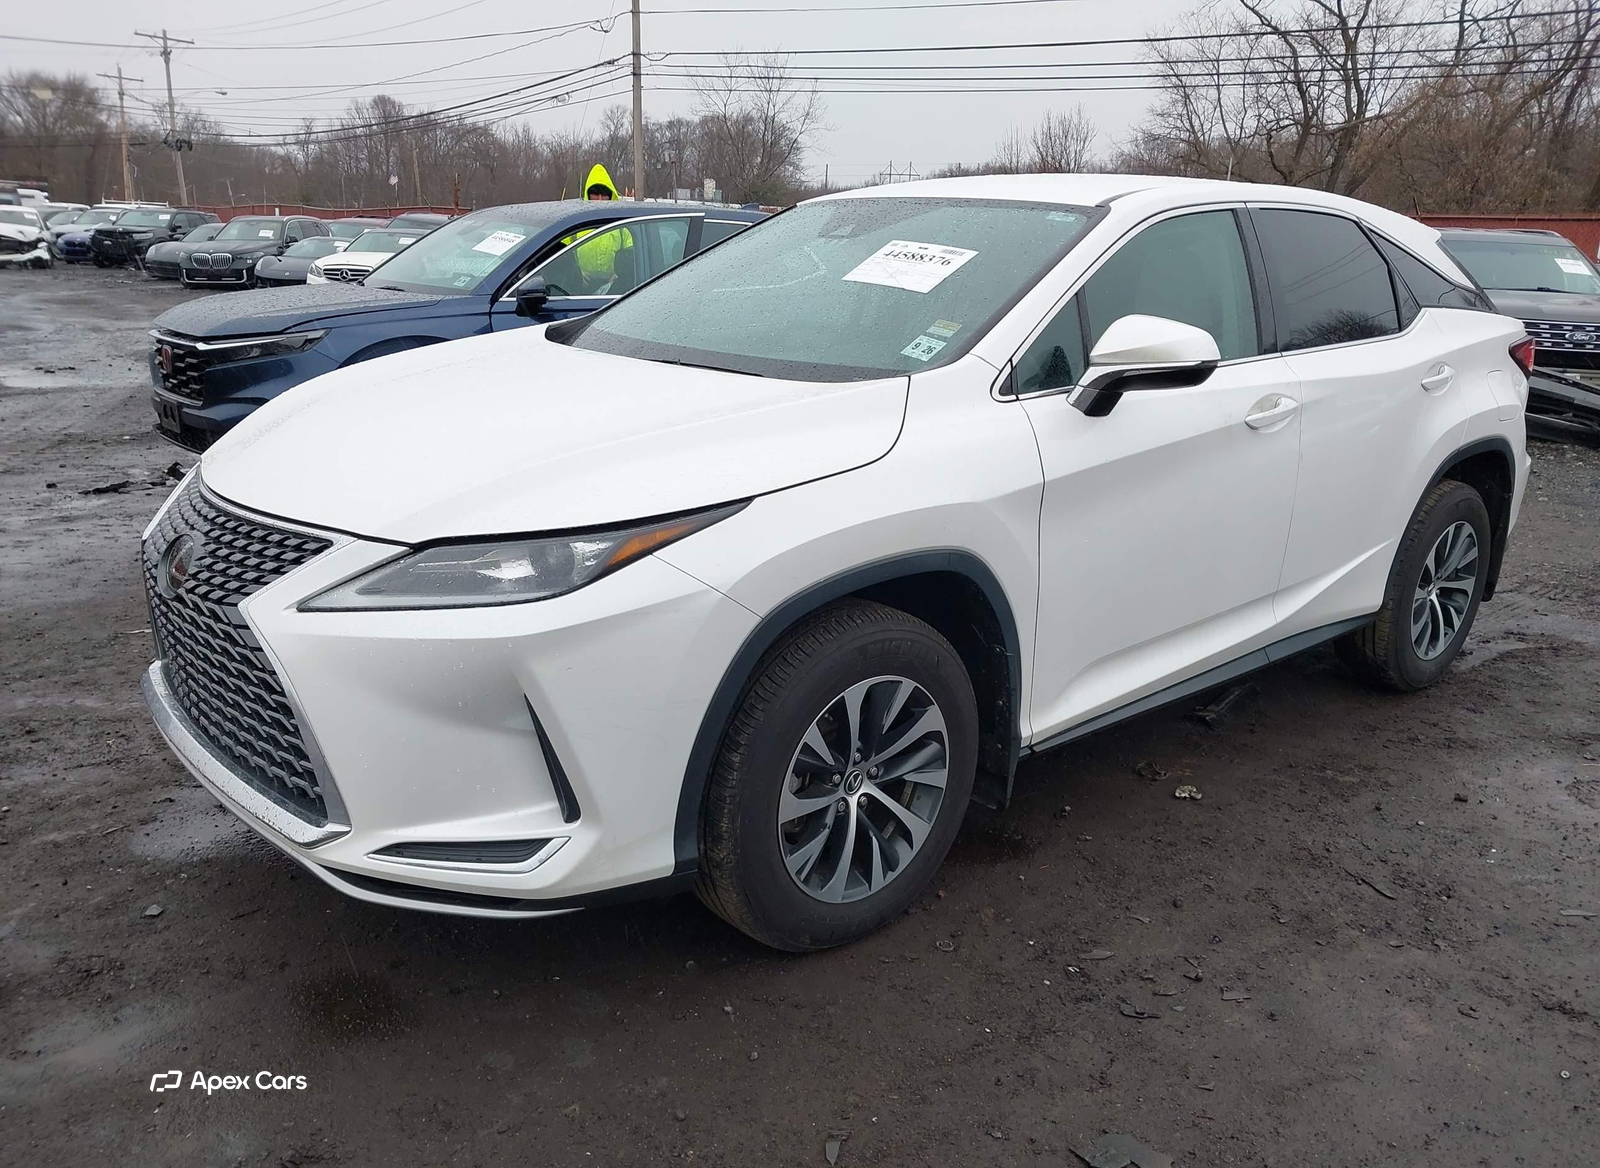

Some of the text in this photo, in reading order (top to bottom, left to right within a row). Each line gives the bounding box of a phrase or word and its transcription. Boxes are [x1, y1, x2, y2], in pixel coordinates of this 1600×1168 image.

[883, 250, 951, 266] 44588376
[911, 342, 921, 350] 9
[921, 345, 936, 355] 26
